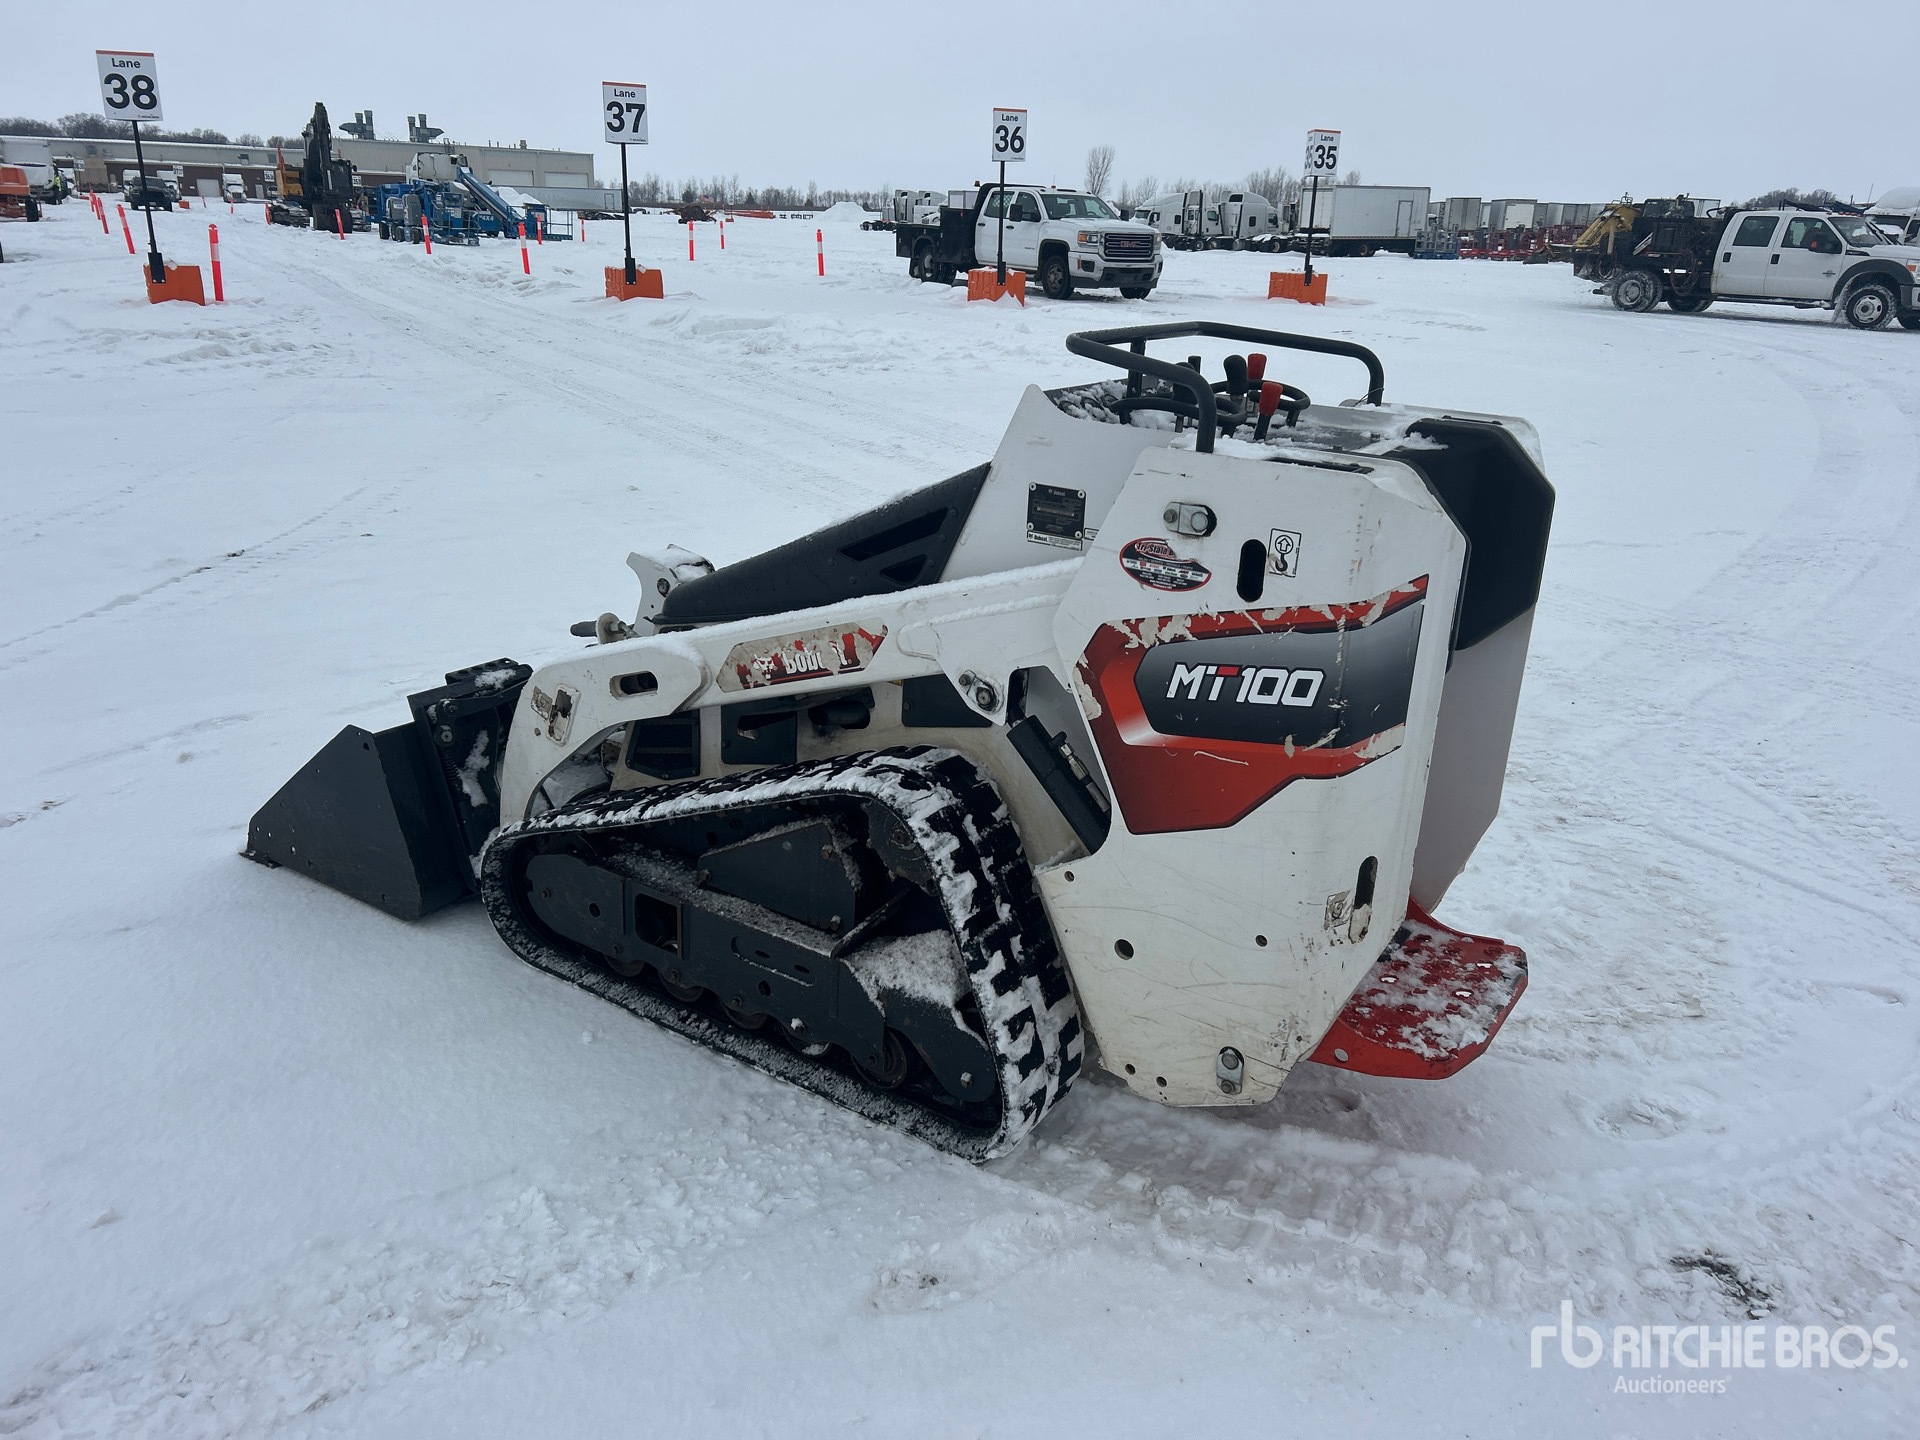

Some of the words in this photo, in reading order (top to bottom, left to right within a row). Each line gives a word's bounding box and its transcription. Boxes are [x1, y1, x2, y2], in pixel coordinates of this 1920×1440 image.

[112, 58, 141, 68] Lane
[104, 73, 158, 110] 38
[614, 88, 636, 98] Lane
[607, 101, 645, 133] 37
[1001, 113, 1019, 121] Lane
[995, 124, 1024, 153] 36
[1313, 144, 1337, 170] 35
[1166, 663, 1325, 708] MT100
